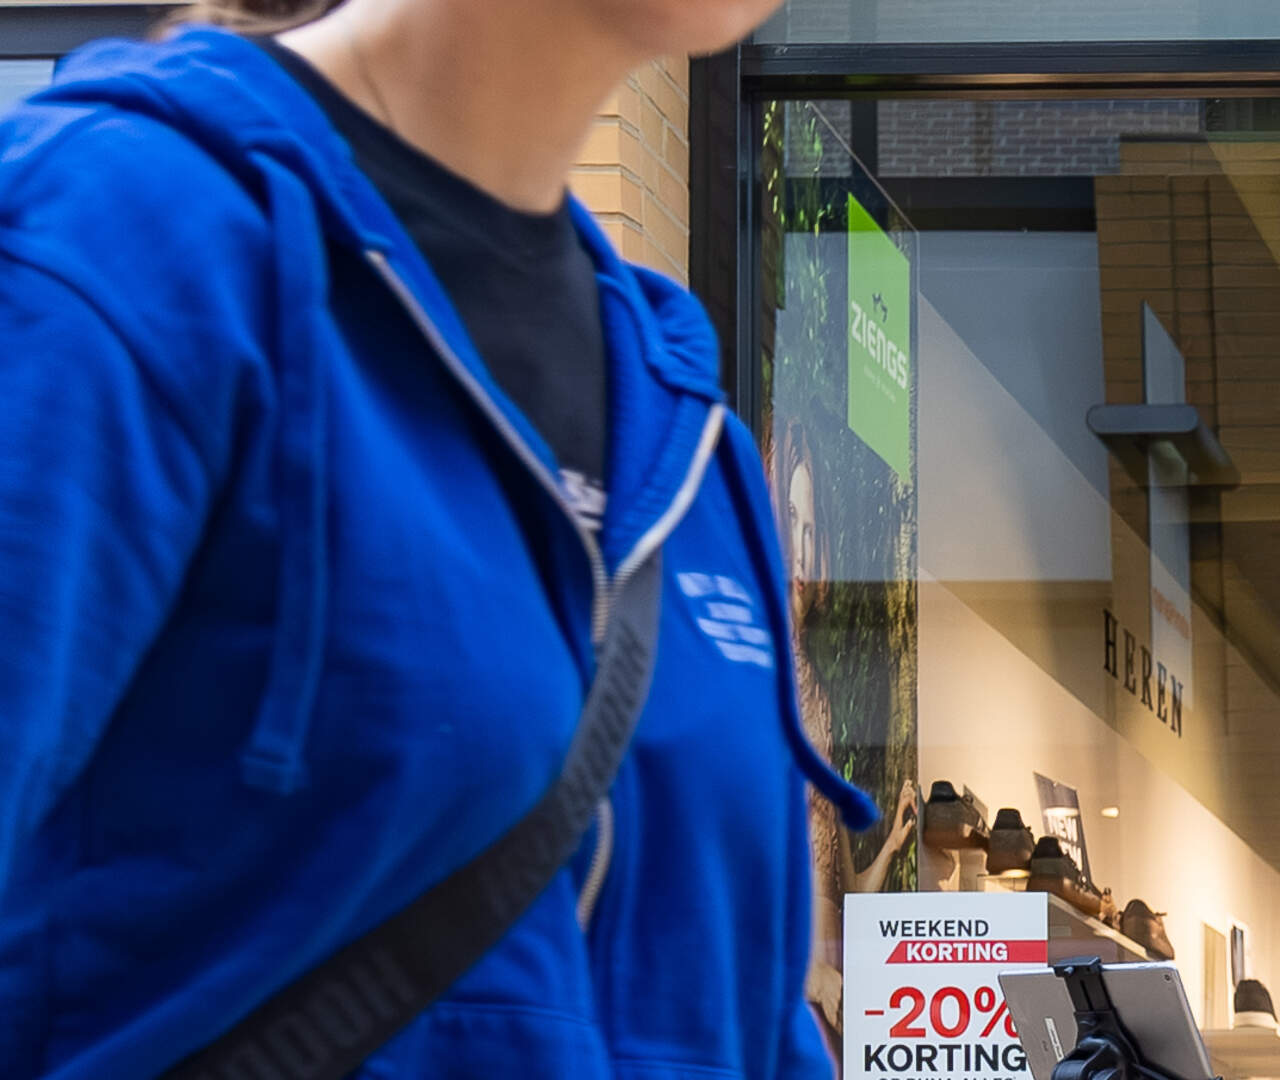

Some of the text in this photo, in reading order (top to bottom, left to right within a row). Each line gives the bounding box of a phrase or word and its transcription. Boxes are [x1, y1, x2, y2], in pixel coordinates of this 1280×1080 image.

[851, 301, 907, 389] ZIENGS
[1103, 608, 1183, 738] HEREN
[879, 920, 989, 937] WEEKEND
[907, 942, 1008, 961] KORTING
[865, 986, 1019, 1038] -20%
[864, 1044, 1027, 1072] KORTING
